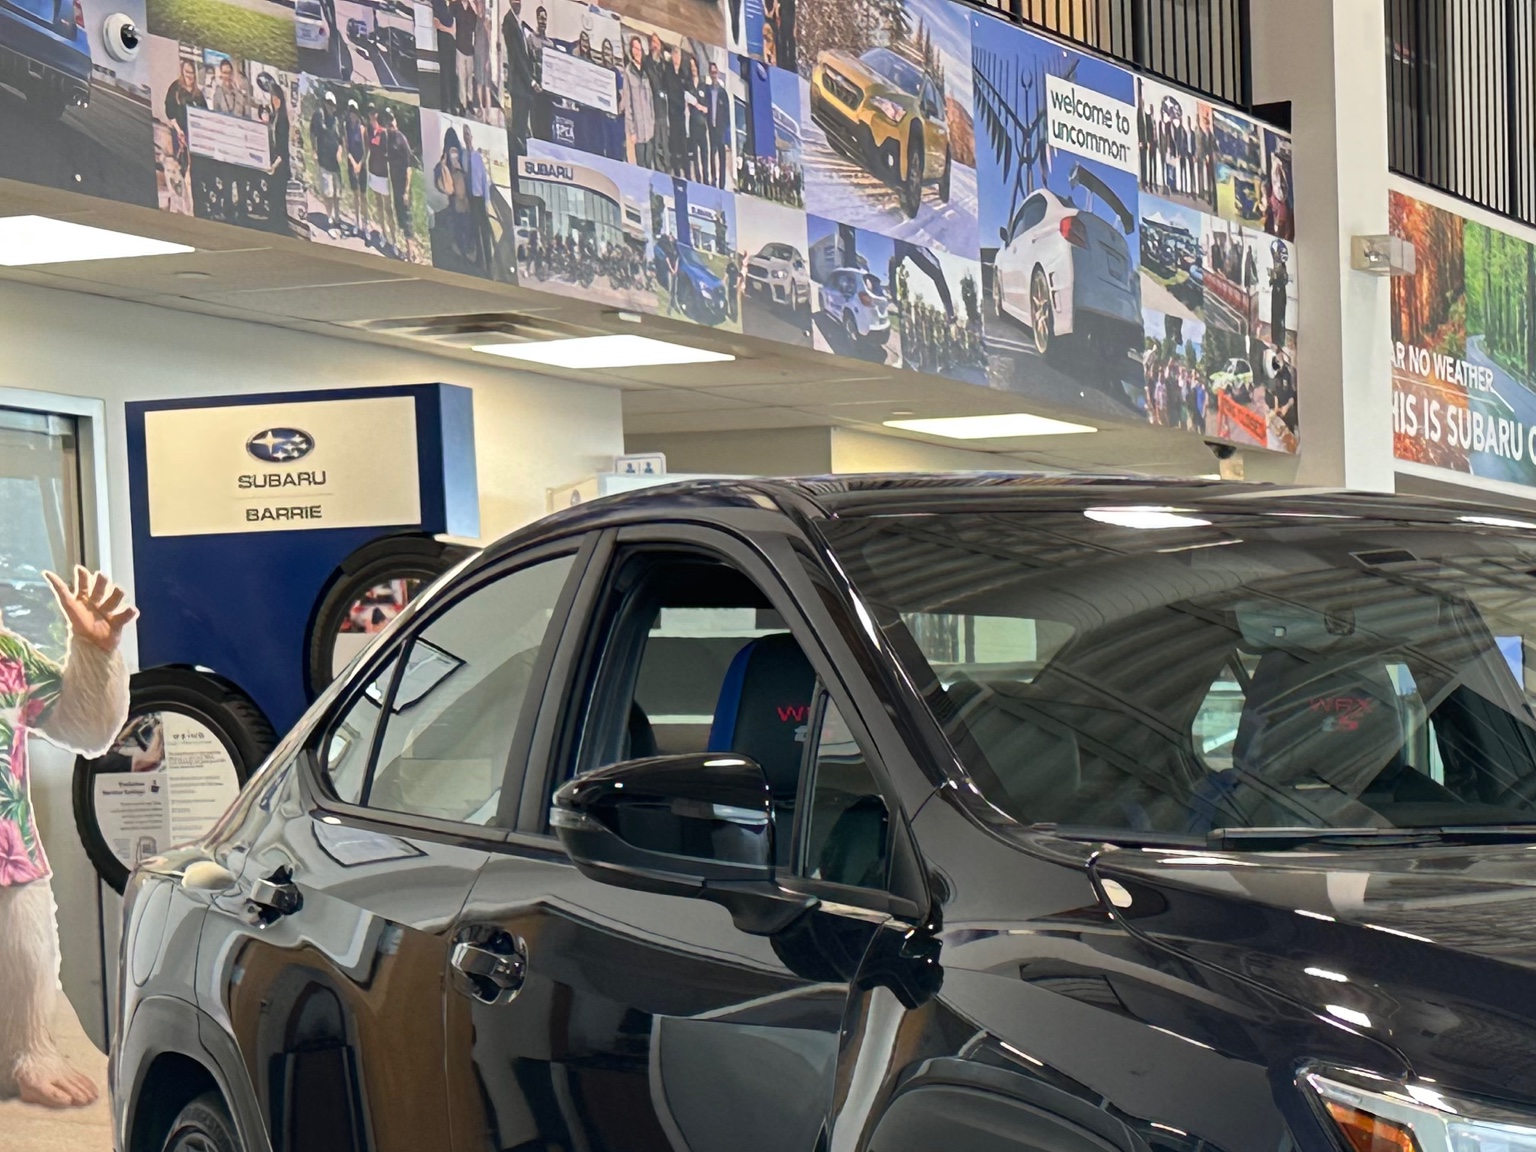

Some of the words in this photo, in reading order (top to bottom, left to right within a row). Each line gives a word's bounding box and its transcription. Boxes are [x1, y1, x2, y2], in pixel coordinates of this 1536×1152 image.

[1050, 87, 1113, 129] welcome
[1115, 109, 1130, 135] to
[524, 161, 573, 180] SUBARU
[1408, 345, 1431, 377] NO
[1432, 351, 1494, 392] WEATHER
[1423, 397, 1442, 442] IS
[1446, 404, 1524, 461] SUBARU
[238, 470, 327, 489] SUBARU
[245, 505, 323, 522] BARRIE
